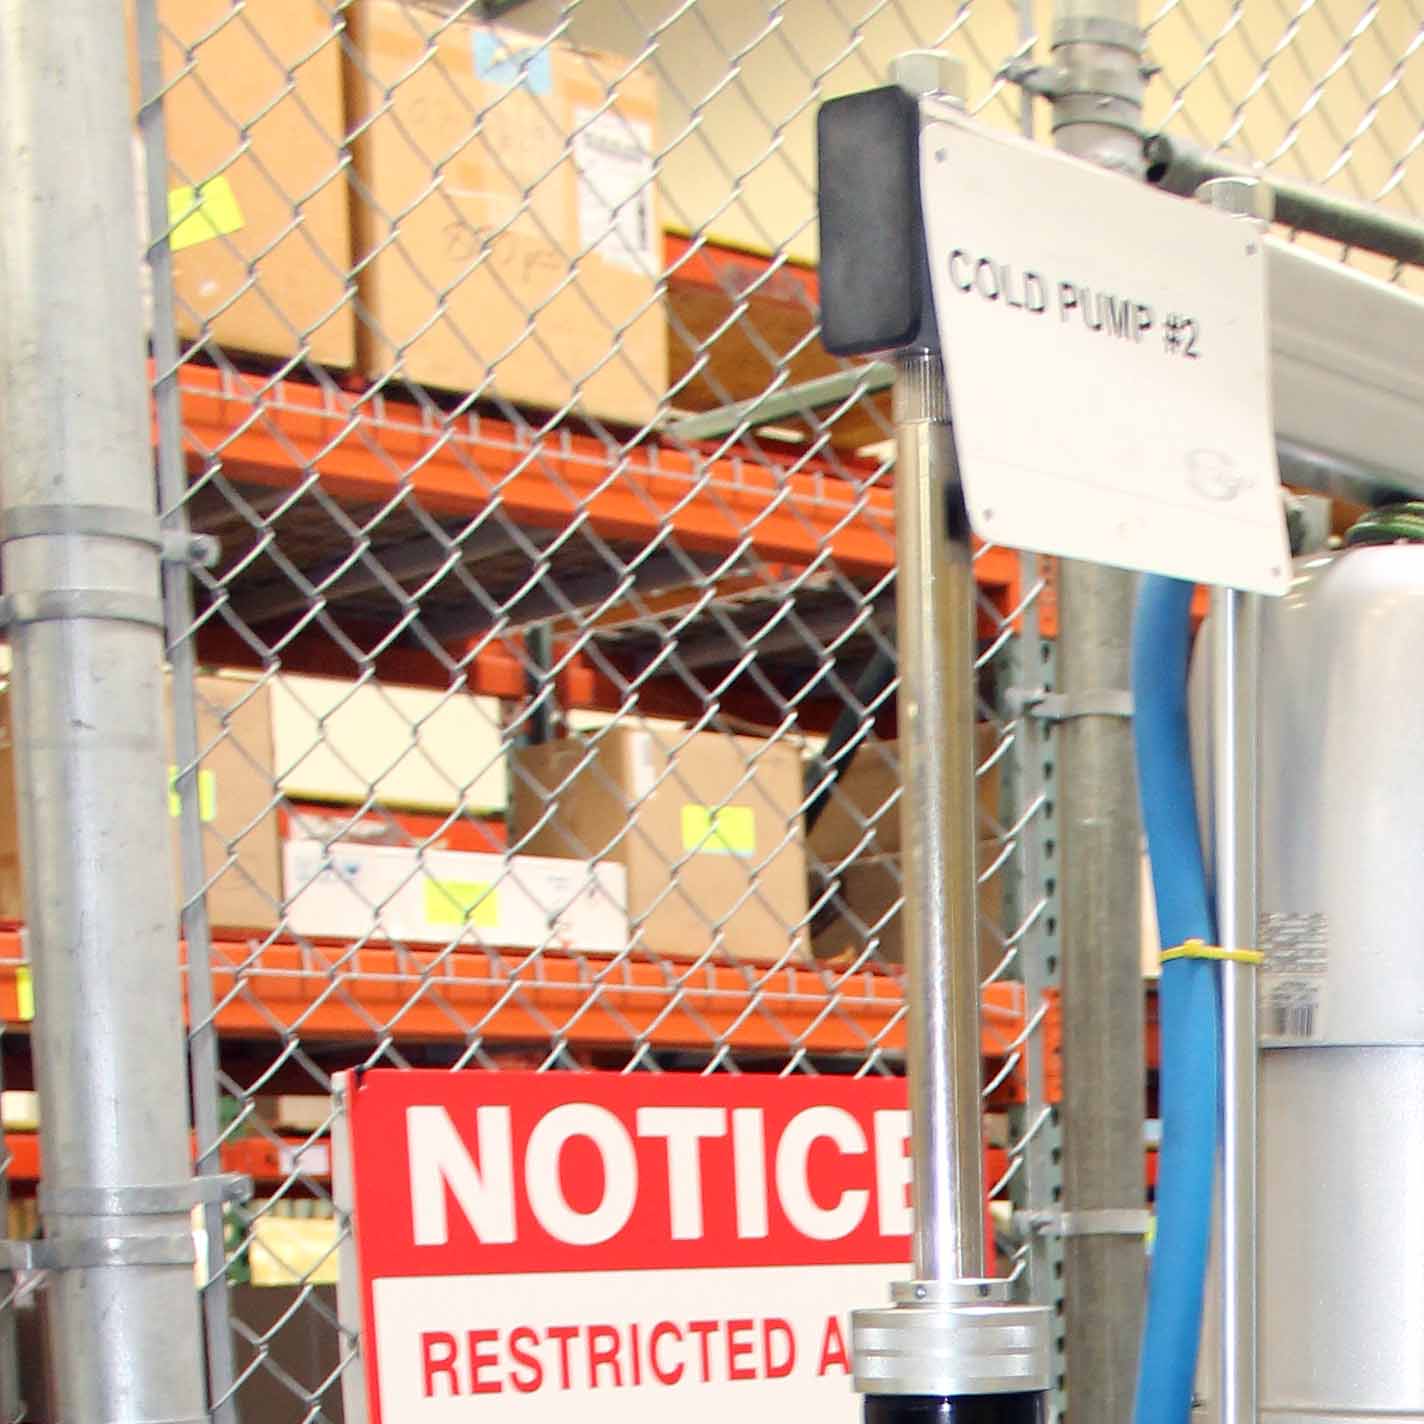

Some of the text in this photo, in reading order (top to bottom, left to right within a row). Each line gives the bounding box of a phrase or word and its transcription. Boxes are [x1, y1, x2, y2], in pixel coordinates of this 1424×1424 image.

[950, 249, 1200, 358] COLD PUMP #2
[420, 1317, 796, 1398] RESTRICTED
